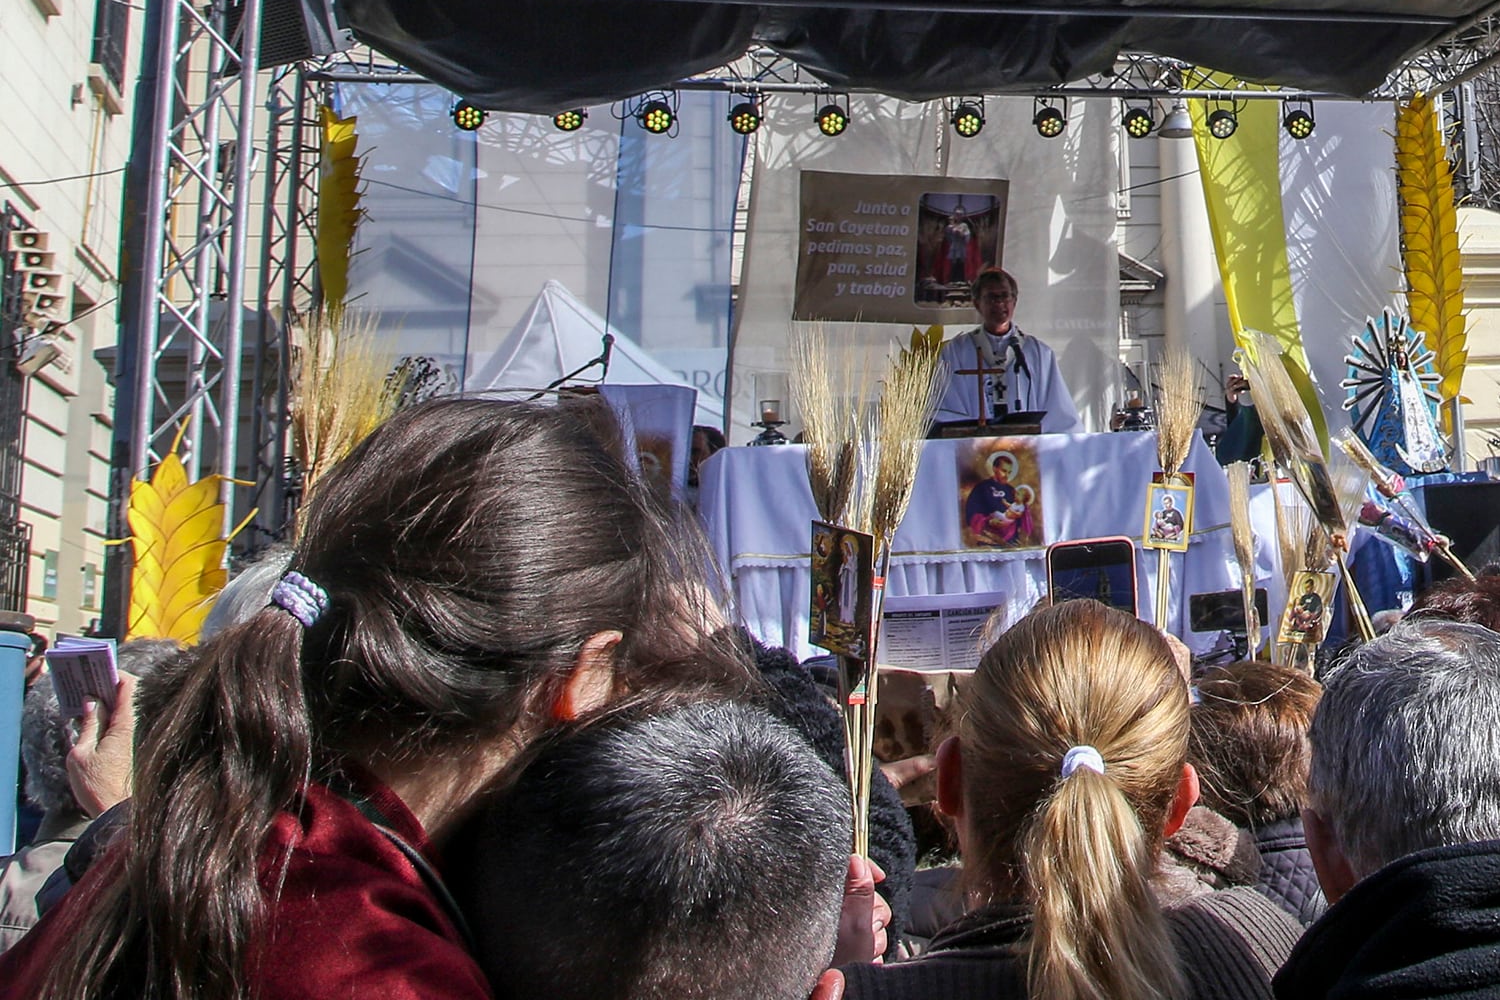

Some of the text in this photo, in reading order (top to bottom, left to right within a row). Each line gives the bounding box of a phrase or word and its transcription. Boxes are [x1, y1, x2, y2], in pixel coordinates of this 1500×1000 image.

[854, 200, 911, 216] Junto a
[806, 218, 910, 237] San Cayetano
[807, 239, 907, 258] pedimos paz,
[827, 261, 908, 277] pan, salud
[835, 281, 906, 299] y trabajo
